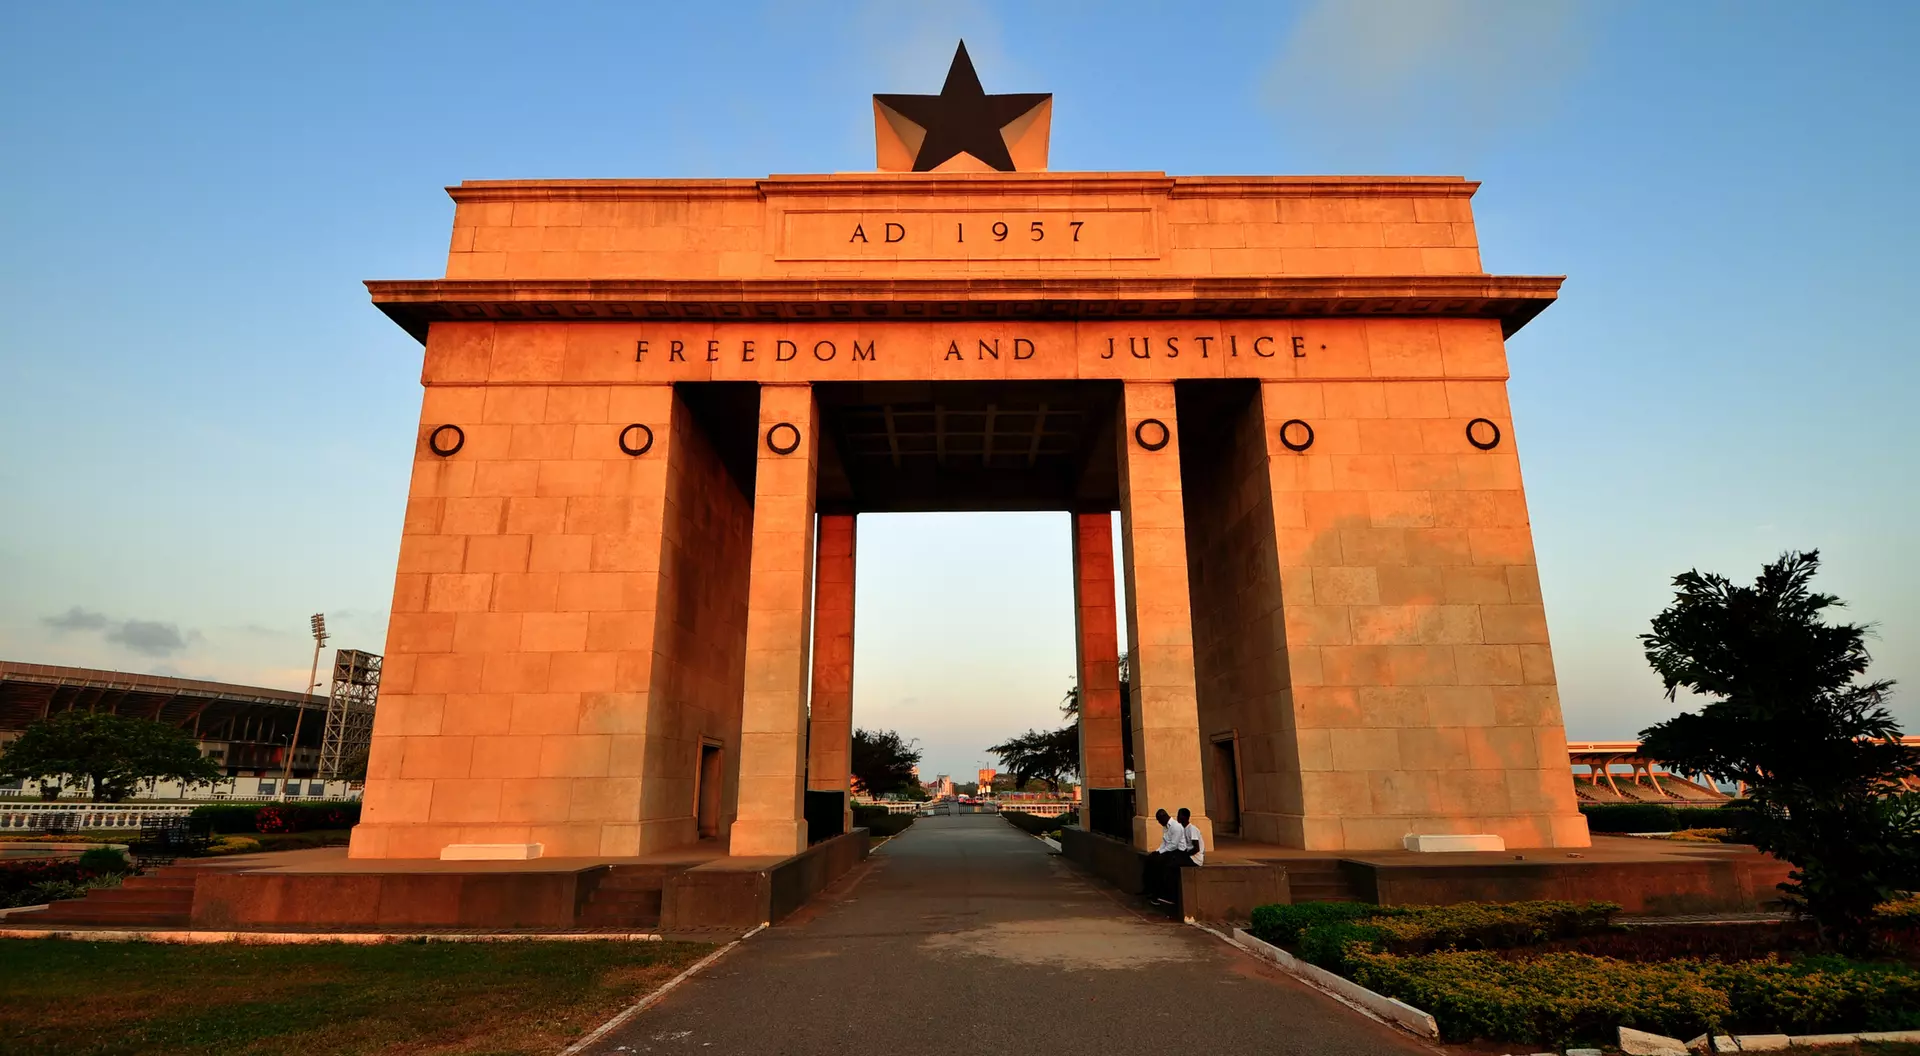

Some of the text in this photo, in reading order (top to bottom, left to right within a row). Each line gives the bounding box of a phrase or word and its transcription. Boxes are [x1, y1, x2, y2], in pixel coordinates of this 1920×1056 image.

[848, 221, 1085, 243] AD 1957
[635, 339, 877, 363] FREEDOM
[943, 338, 1036, 361] AND
